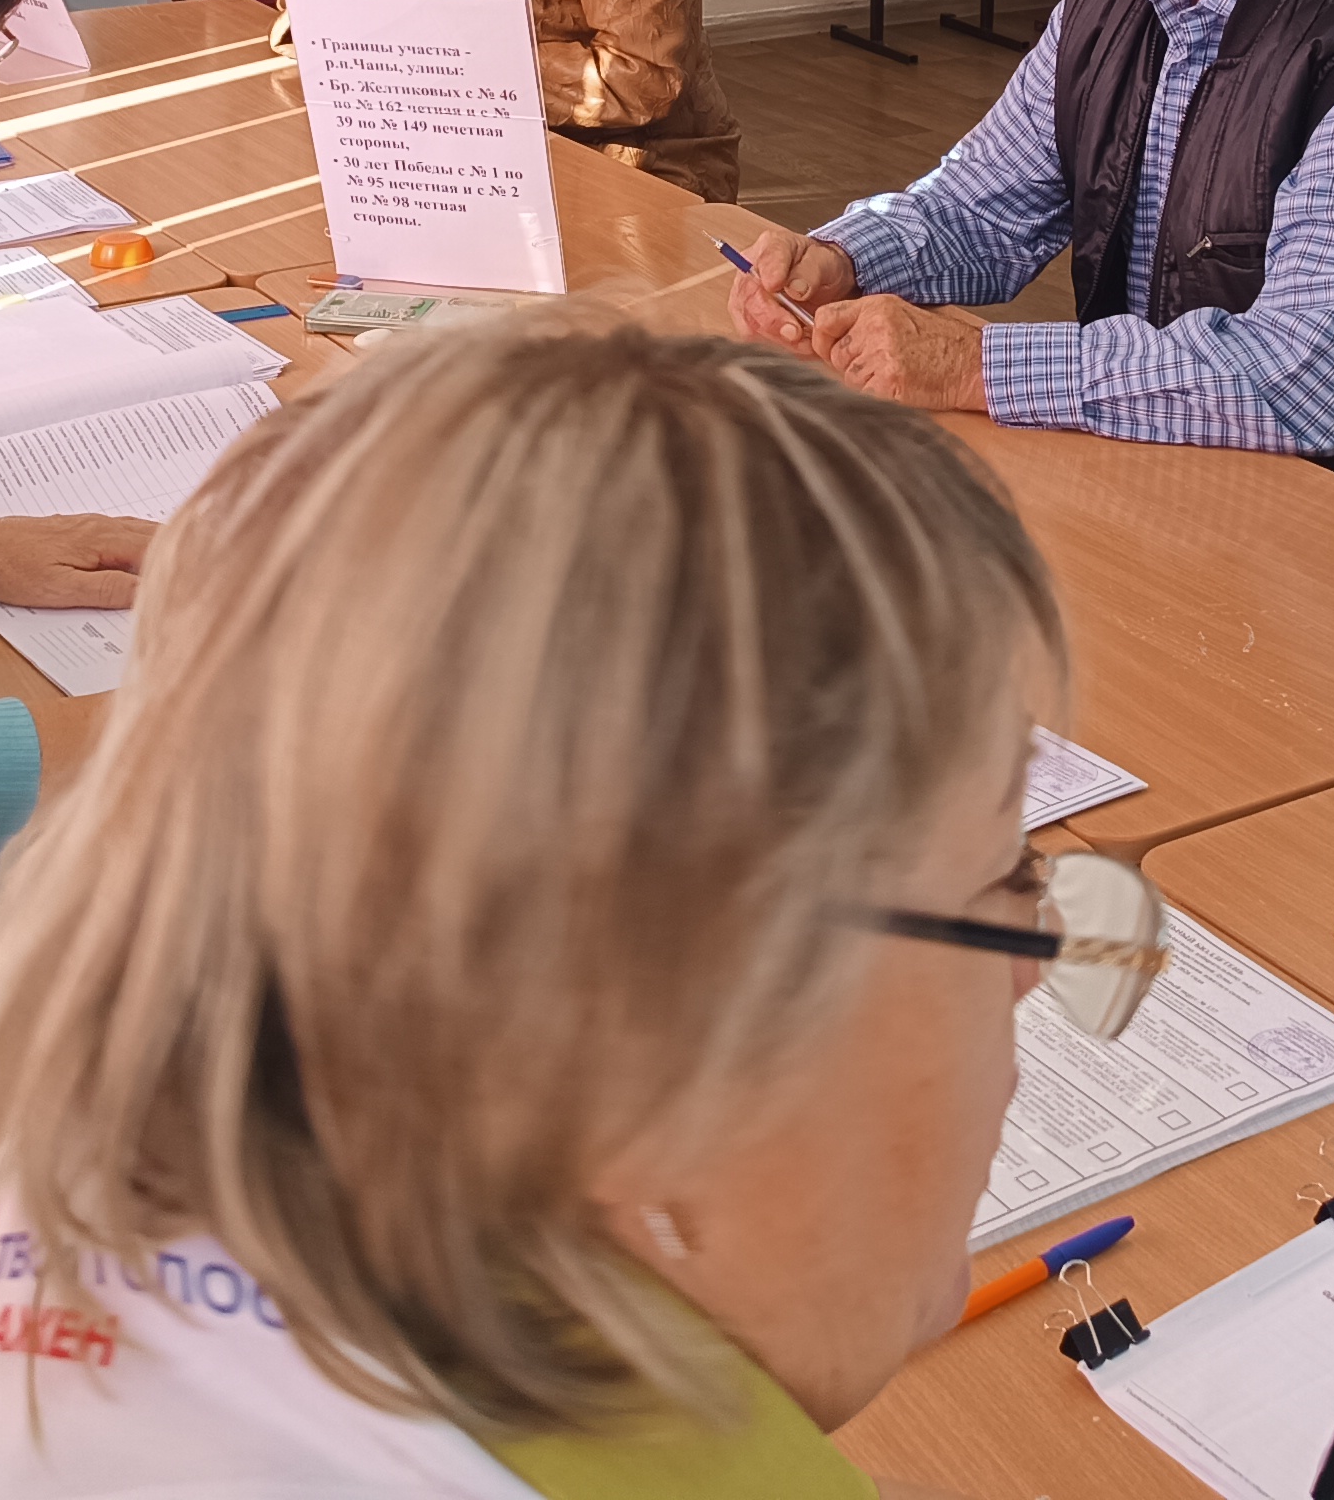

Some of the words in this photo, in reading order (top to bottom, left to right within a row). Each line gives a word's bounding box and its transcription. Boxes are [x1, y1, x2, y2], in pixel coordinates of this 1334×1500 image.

[321, 37, 394, 55] Границы
[397, 44, 460, 58] участка
[325, 56, 403, 74] р.п.Чаны,
[407, 62, 464, 77] улицы:
[329, 79, 355, 93] Бр.
[359, 80, 461, 99] Желтиковых
[499, 89, 517, 102] 46
[333, 99, 351, 111] по
[377, 100, 403, 112] 162
[407, 104, 462, 117] четная
[336, 115, 353, 128] 39
[358, 119, 376, 130] по
[402, 120, 428, 133] 149
[432, 124, 504, 138] нечетная
[339, 135, 411, 152] стороны,
[343, 156, 361, 169] 30
[364, 159, 389, 171] лет
[394, 159, 454, 176] Победы
[491, 167, 498, 179] 1
[504, 170, 524, 181] по
[367, 176, 385, 189] 95
[388, 179, 458, 195] нечетная
[511, 186, 520, 198] 2
[350, 194, 368, 205] по
[392, 196, 410, 208] 98
[414, 200, 467, 213] четная
[353, 211, 422, 227] стороны.
